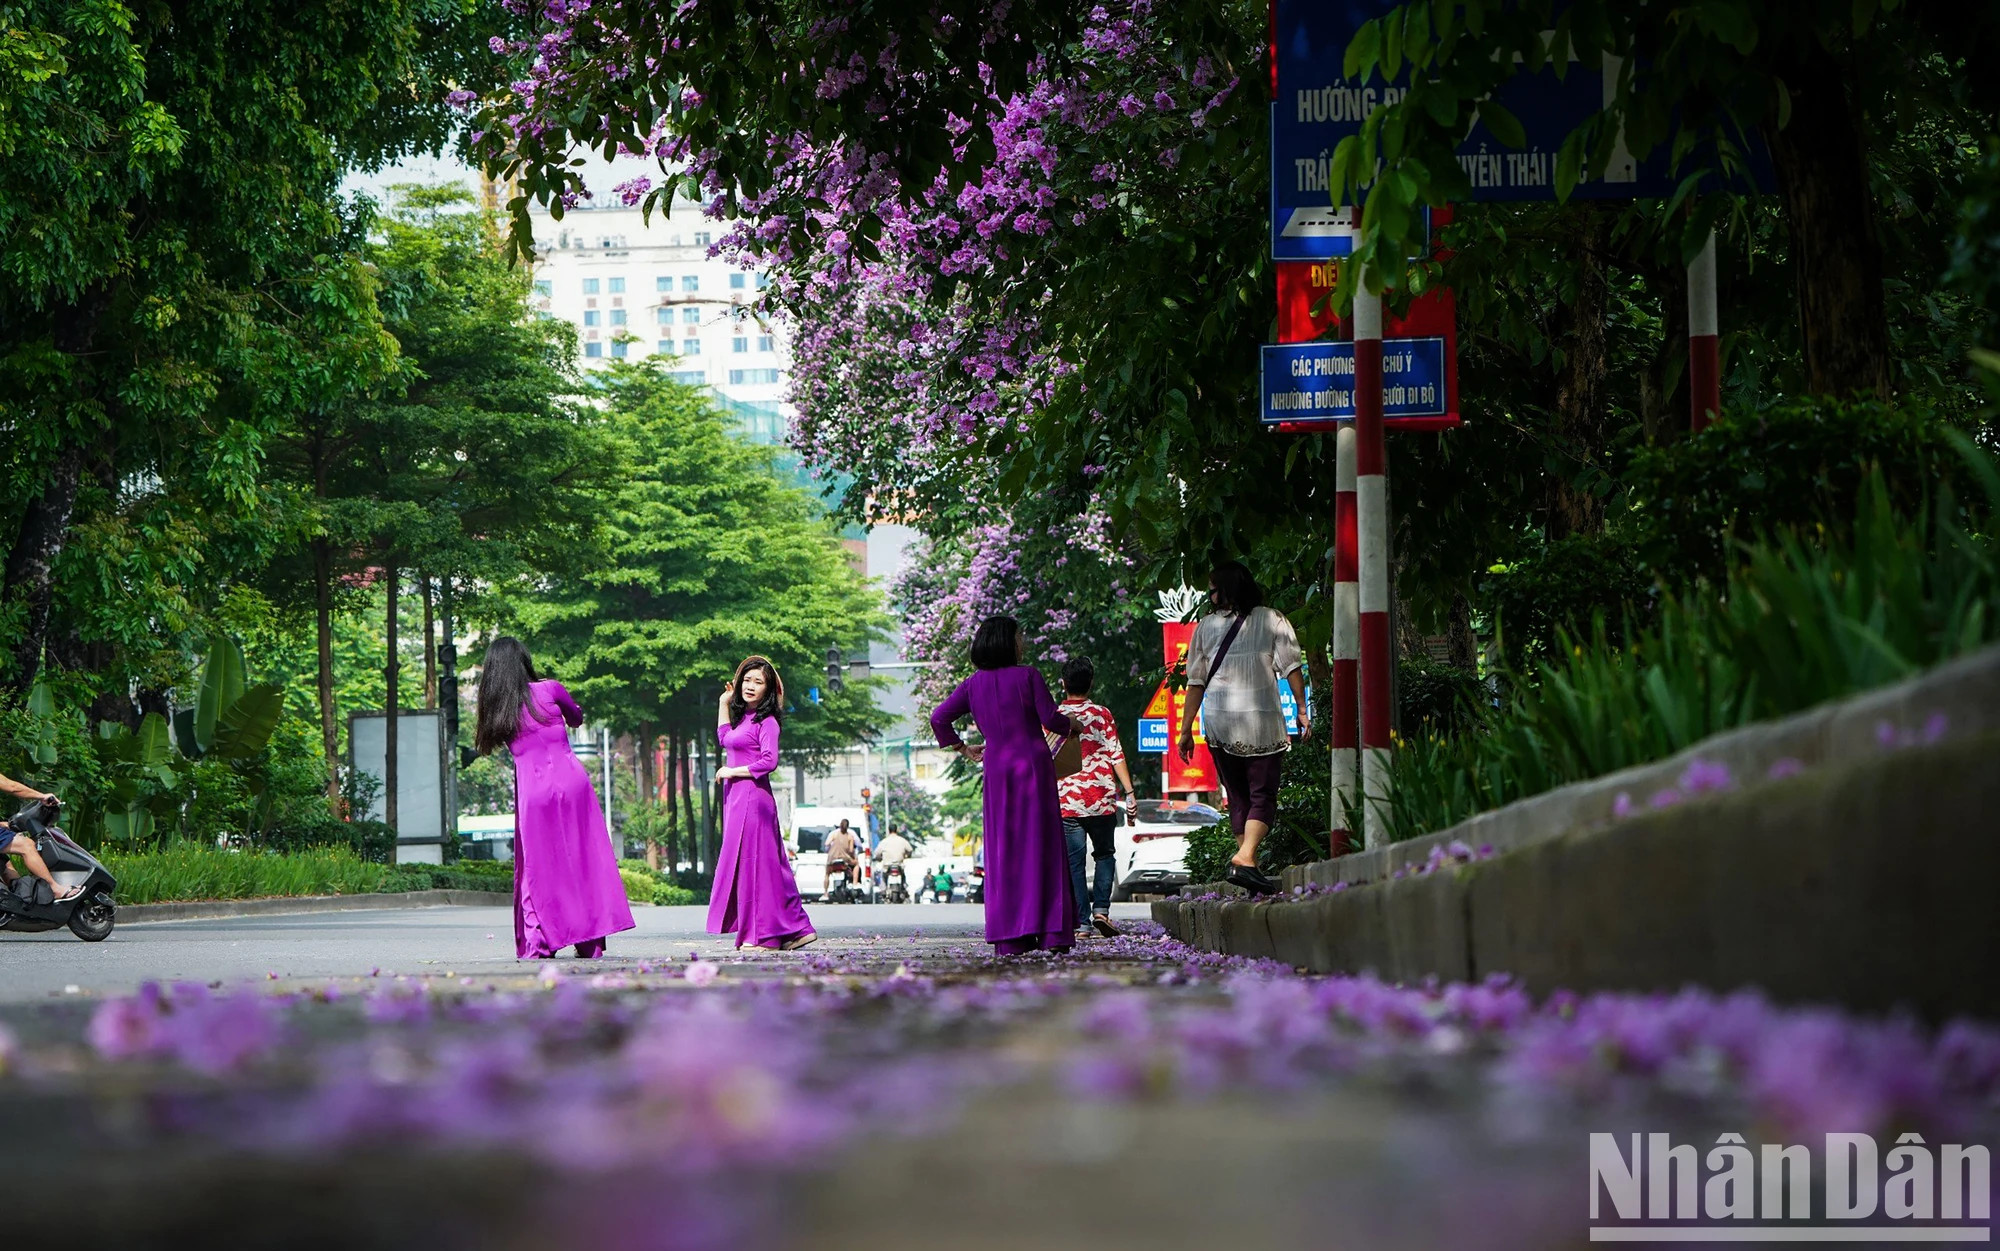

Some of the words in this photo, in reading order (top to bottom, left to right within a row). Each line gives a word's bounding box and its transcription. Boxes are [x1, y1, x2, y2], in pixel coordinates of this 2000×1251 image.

[1297, 78, 1377, 123] HƯỚNG
[1506, 145, 1547, 187] THÁI
[1291, 355, 1312, 377] CÁC
[1314, 355, 1355, 376] PHƯƠNG
[1382, 351, 1403, 373] CHÚ
[1405, 350, 1412, 373] Ý
[1271, 387, 1312, 410] NHƯỜNG
[1314, 386, 1349, 409] ĐƯỜNG
[1382, 383, 1405, 406] GƯỜI
[1408, 386, 1418, 405] ĐI
[1421, 382, 1434, 407] BỘ
